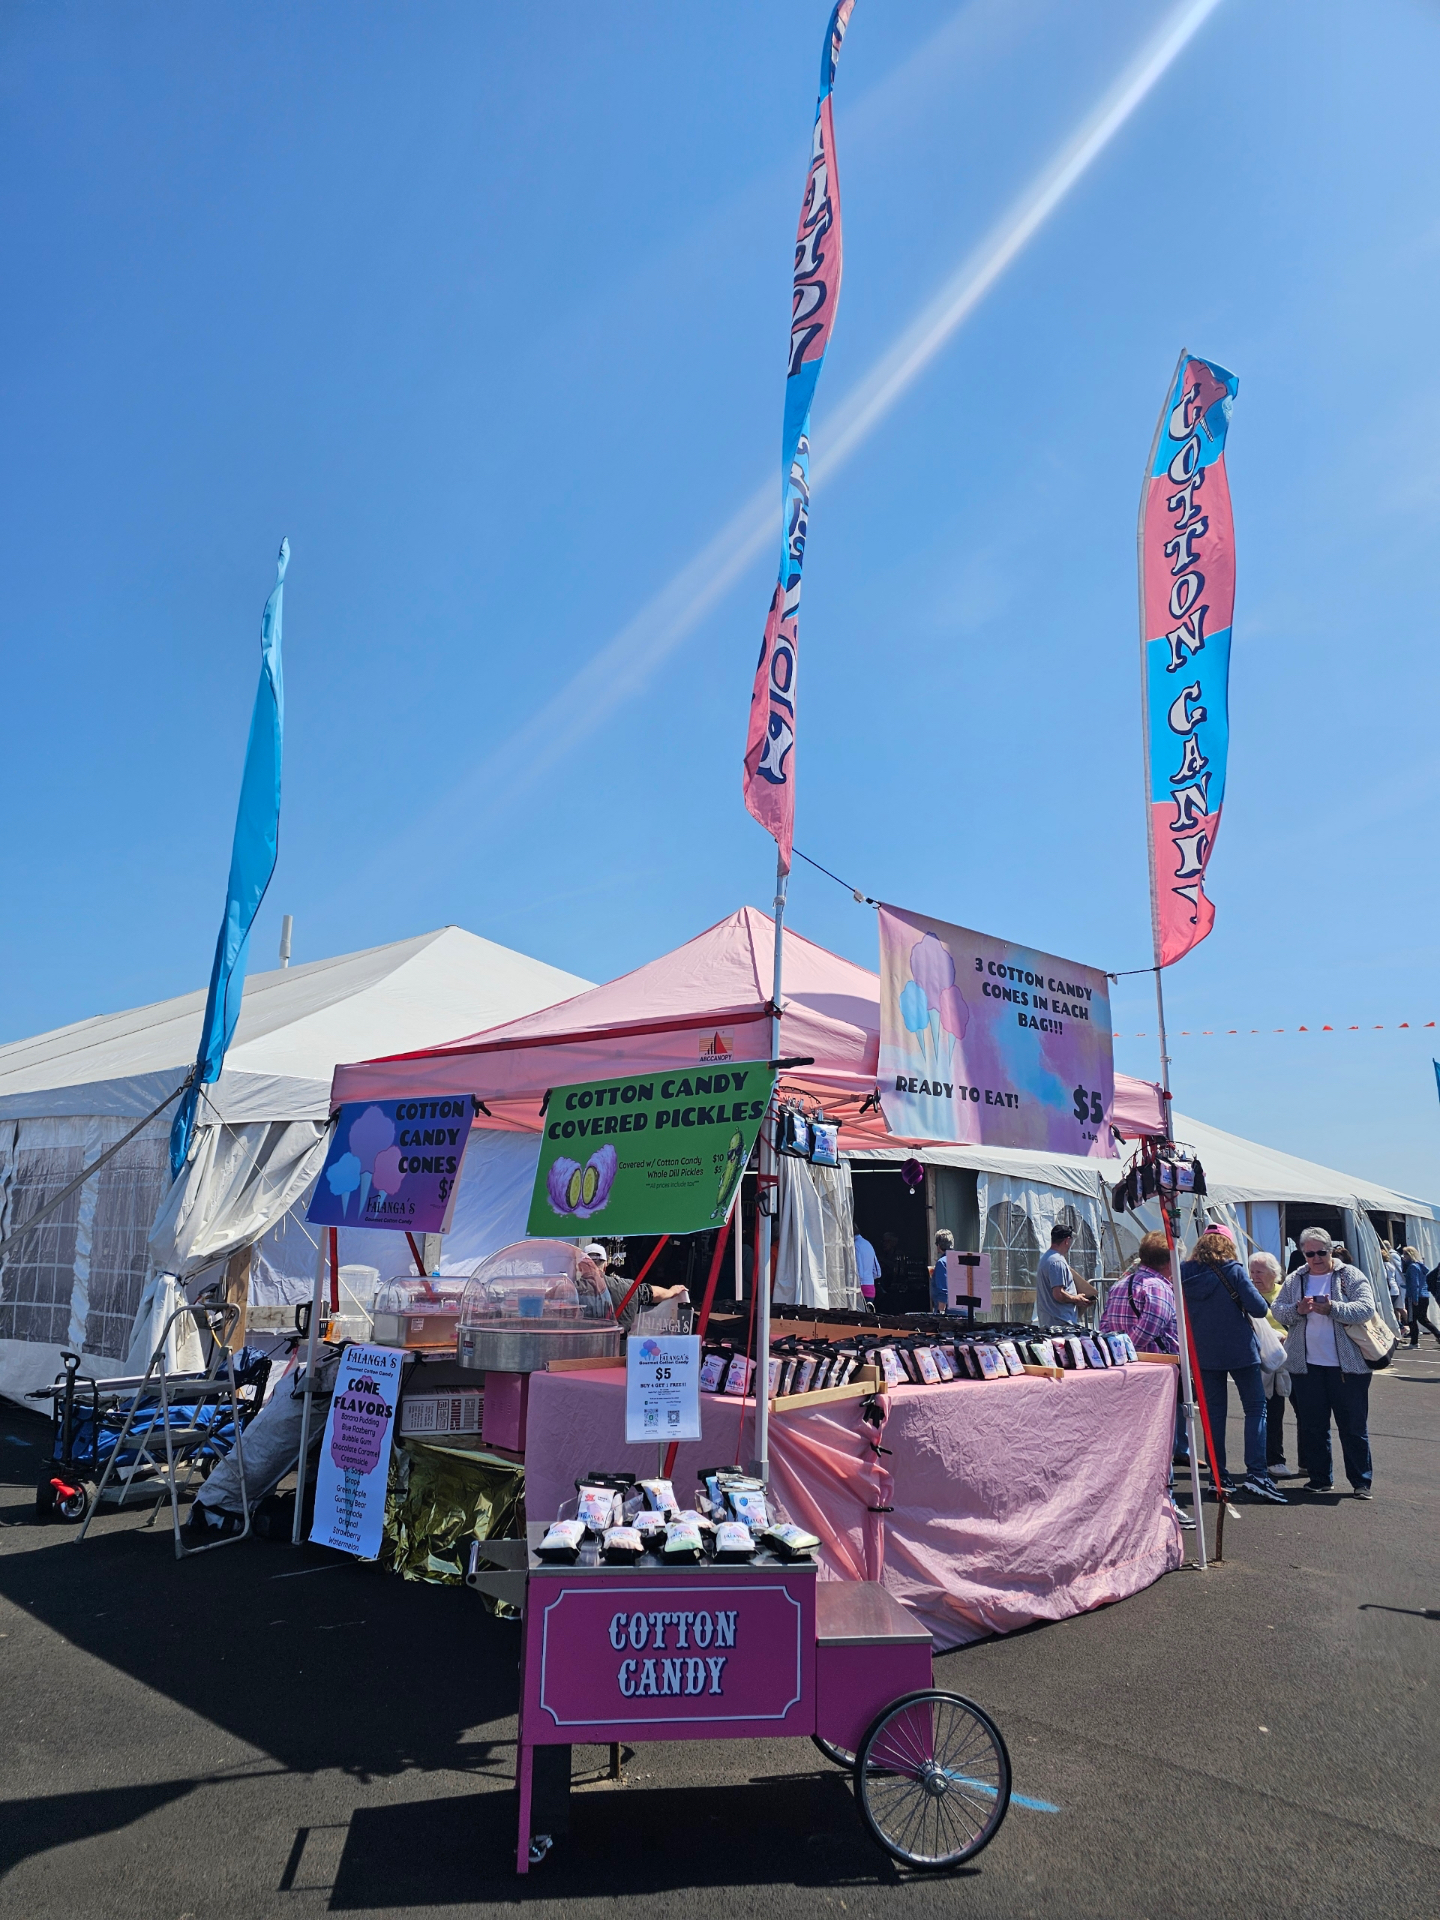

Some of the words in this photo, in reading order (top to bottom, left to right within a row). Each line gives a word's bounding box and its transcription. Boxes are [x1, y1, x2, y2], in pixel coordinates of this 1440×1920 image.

[975, 957, 984, 973] 3
[987, 961, 1044, 989] COTTON
[1048, 978, 1092, 1001] CANDY
[982, 982, 1029, 1007] CONES
[1033, 994, 1048, 1011] IN
[1052, 998, 1089, 1020] EACH
[1017, 1012, 1063, 1036] BAG!!!
[565, 1082, 654, 1111] COTTON
[661, 1071, 749, 1100] CANDY
[895, 1075, 954, 1099] READY
[959, 1085, 981, 1103] TO
[985, 1092, 1019, 1110] EAT!
[396, 1100, 465, 1121] COTTON
[1073, 1085, 1104, 1125] $5
[548, 1112, 648, 1140] COVERED
[655, 1100, 765, 1130] PICKLES
[399, 1128, 461, 1147] CANDY
[1082, 1132, 1087, 1140] a
[1088, 1130, 1098, 1143] bag
[398, 1156, 457, 1174] CONES
[618, 1160, 645, 1170] Covered
[646, 1160, 656, 1168] w/
[656, 1158, 679, 1167] Cotton
[680, 1156, 703, 1166] Candy
[712, 1154, 725, 1164] $10
[647, 1169, 668, 1179] Whole
[668, 1169, 680, 1178] Dill
[680, 1167, 704, 1177] Pickles
[713, 1165, 722, 1175] $5
[655, 1367, 672, 1381] $5
[348, 1378, 381, 1396] CONE
[333, 1395, 393, 1419] FLAVORS
[341, 1412, 359, 1422] Banana
[359, 1416, 380, 1428] Pudding
[341, 1423, 352, 1432] Blue
[332, 1442, 357, 1454] Chocolate
[341, 1434, 359, 1444] Bubble
[360, 1437, 372, 1446] Gum
[340, 1454, 369, 1467] Creamsicle
[336, 1484, 352, 1495] Green
[352, 1488, 367, 1499] Apple
[334, 1494, 354, 1508] Gummy
[354, 1499, 367, 1509] Bear
[336, 1506, 363, 1519] Lemonade
[338, 1517, 359, 1529] Original
[332, 1526, 361, 1542] Strawberry
[328, 1536, 360, 1551] Watermelon
[608, 1610, 739, 1651] COTTON
[617, 1656, 727, 1697] CANDY
